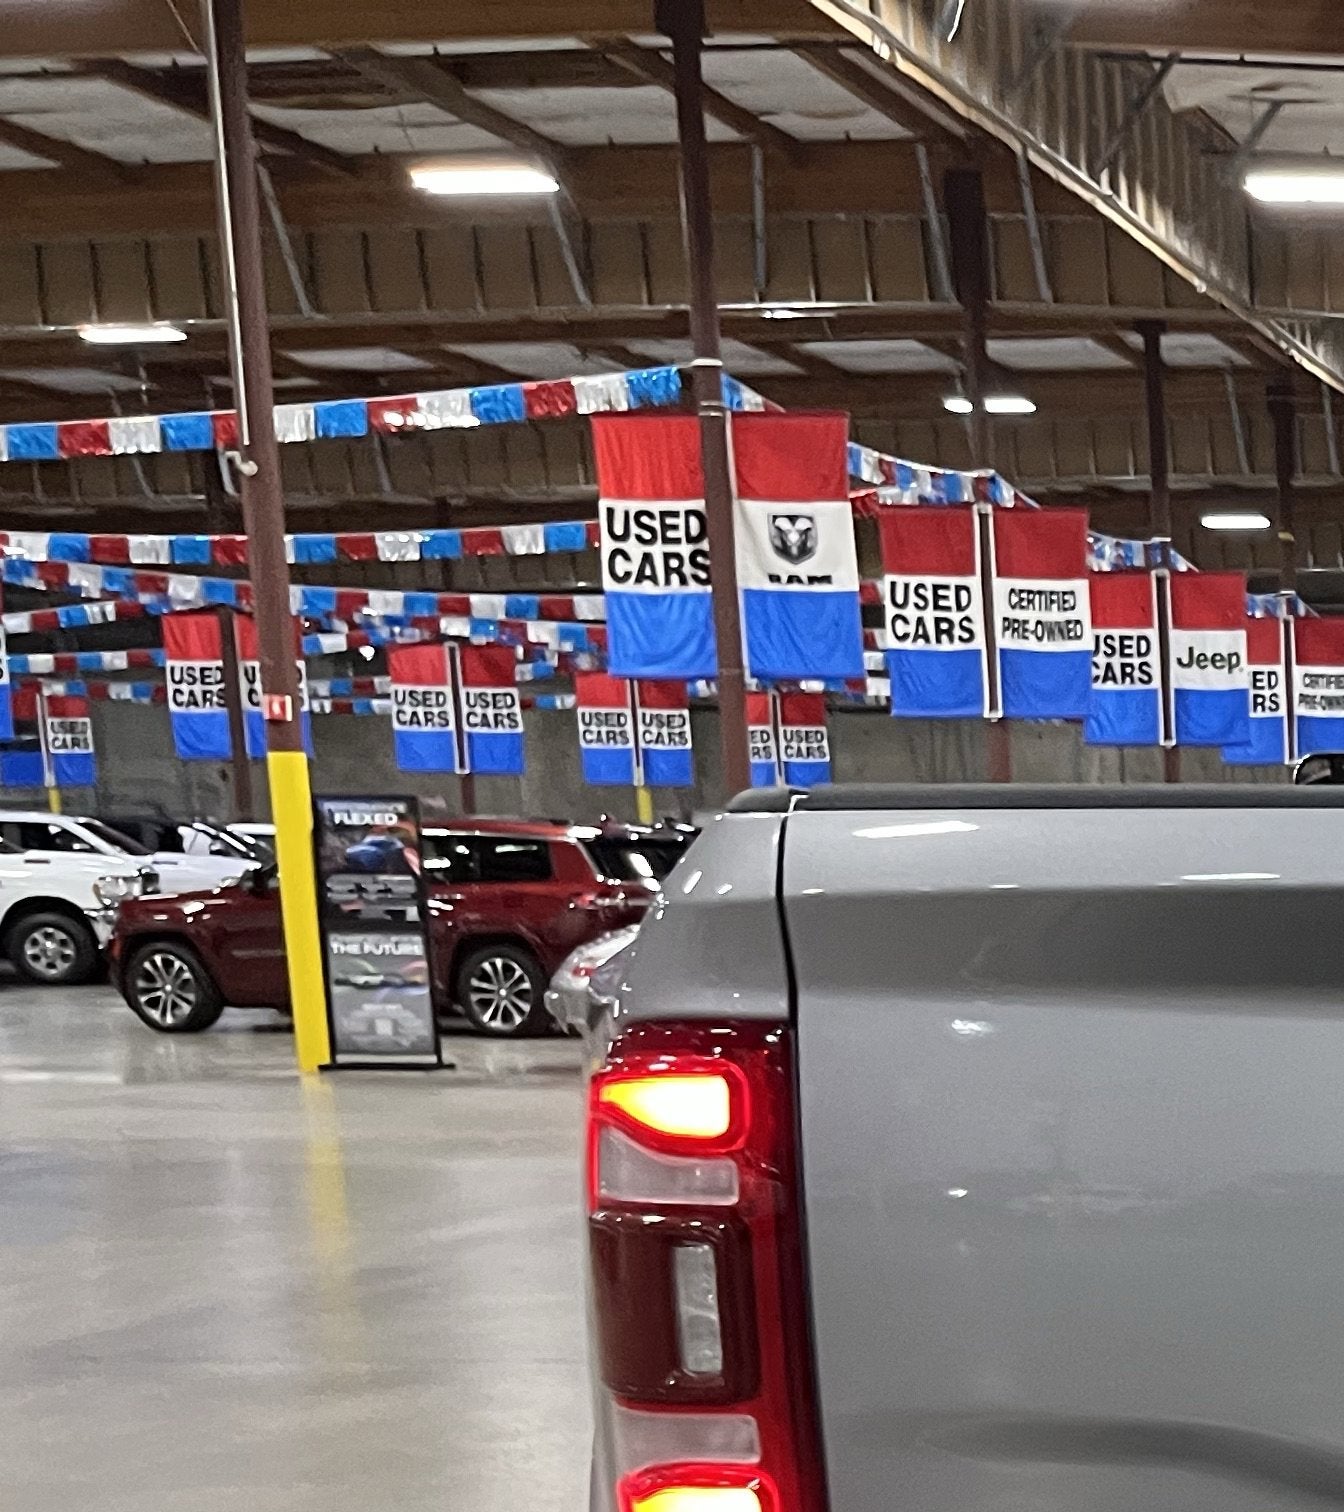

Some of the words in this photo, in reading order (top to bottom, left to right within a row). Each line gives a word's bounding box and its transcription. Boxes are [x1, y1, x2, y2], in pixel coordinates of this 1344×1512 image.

[606, 507, 707, 546] USED
[608, 549, 711, 587] CARS
[890, 581, 972, 612] USED
[1008, 588, 1077, 612] CERTIFIED
[891, 614, 975, 644] CARS
[1001, 617, 1084, 642] PRE-OWNED
[1176, 646, 1241, 674] Jeep
[170, 666, 223, 686] USED
[172, 688, 226, 708] CARS
[394, 690, 447, 708] USED
[465, 692, 516, 710] USED
[396, 711, 450, 728] CARS
[466, 712, 520, 729] CARS
[581, 712, 628, 727] USED
[642, 711, 686, 728] USED
[52, 736, 90, 750] CARS
[583, 730, 630, 745] CARS
[643, 731, 688, 746] CARS
[783, 729, 825, 744] USED
[784, 745, 827, 759] CARS
